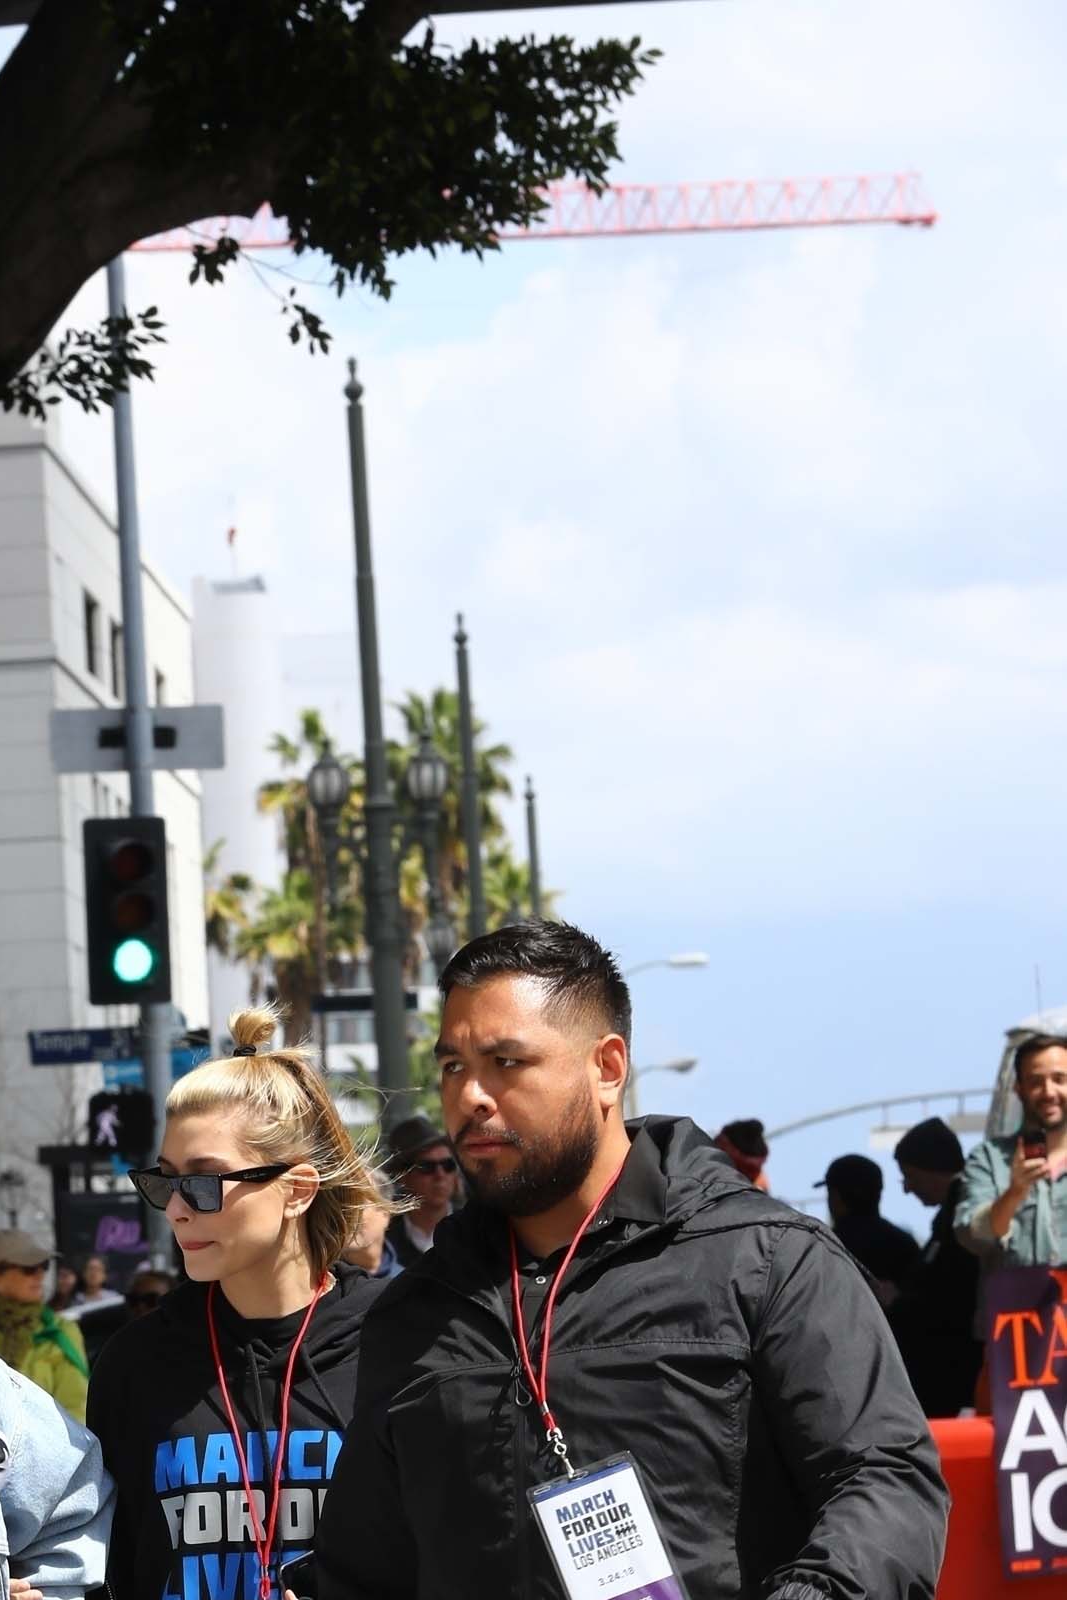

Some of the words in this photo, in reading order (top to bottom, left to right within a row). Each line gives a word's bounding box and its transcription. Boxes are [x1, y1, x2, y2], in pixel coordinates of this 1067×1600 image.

[1000, 1388, 1067, 1470] A
[160, 1489, 267, 1550] FOR
[555, 1489, 616, 1524] MARCH
[561, 1517, 596, 1541] FOR
[597, 1503, 632, 1528] OUR
[567, 1528, 616, 1558] LIVES
[572, 1552, 595, 1570] LOS
[597, 1535, 644, 1563] ANGELES
[598, 1567, 635, 1586] 3.24.18
